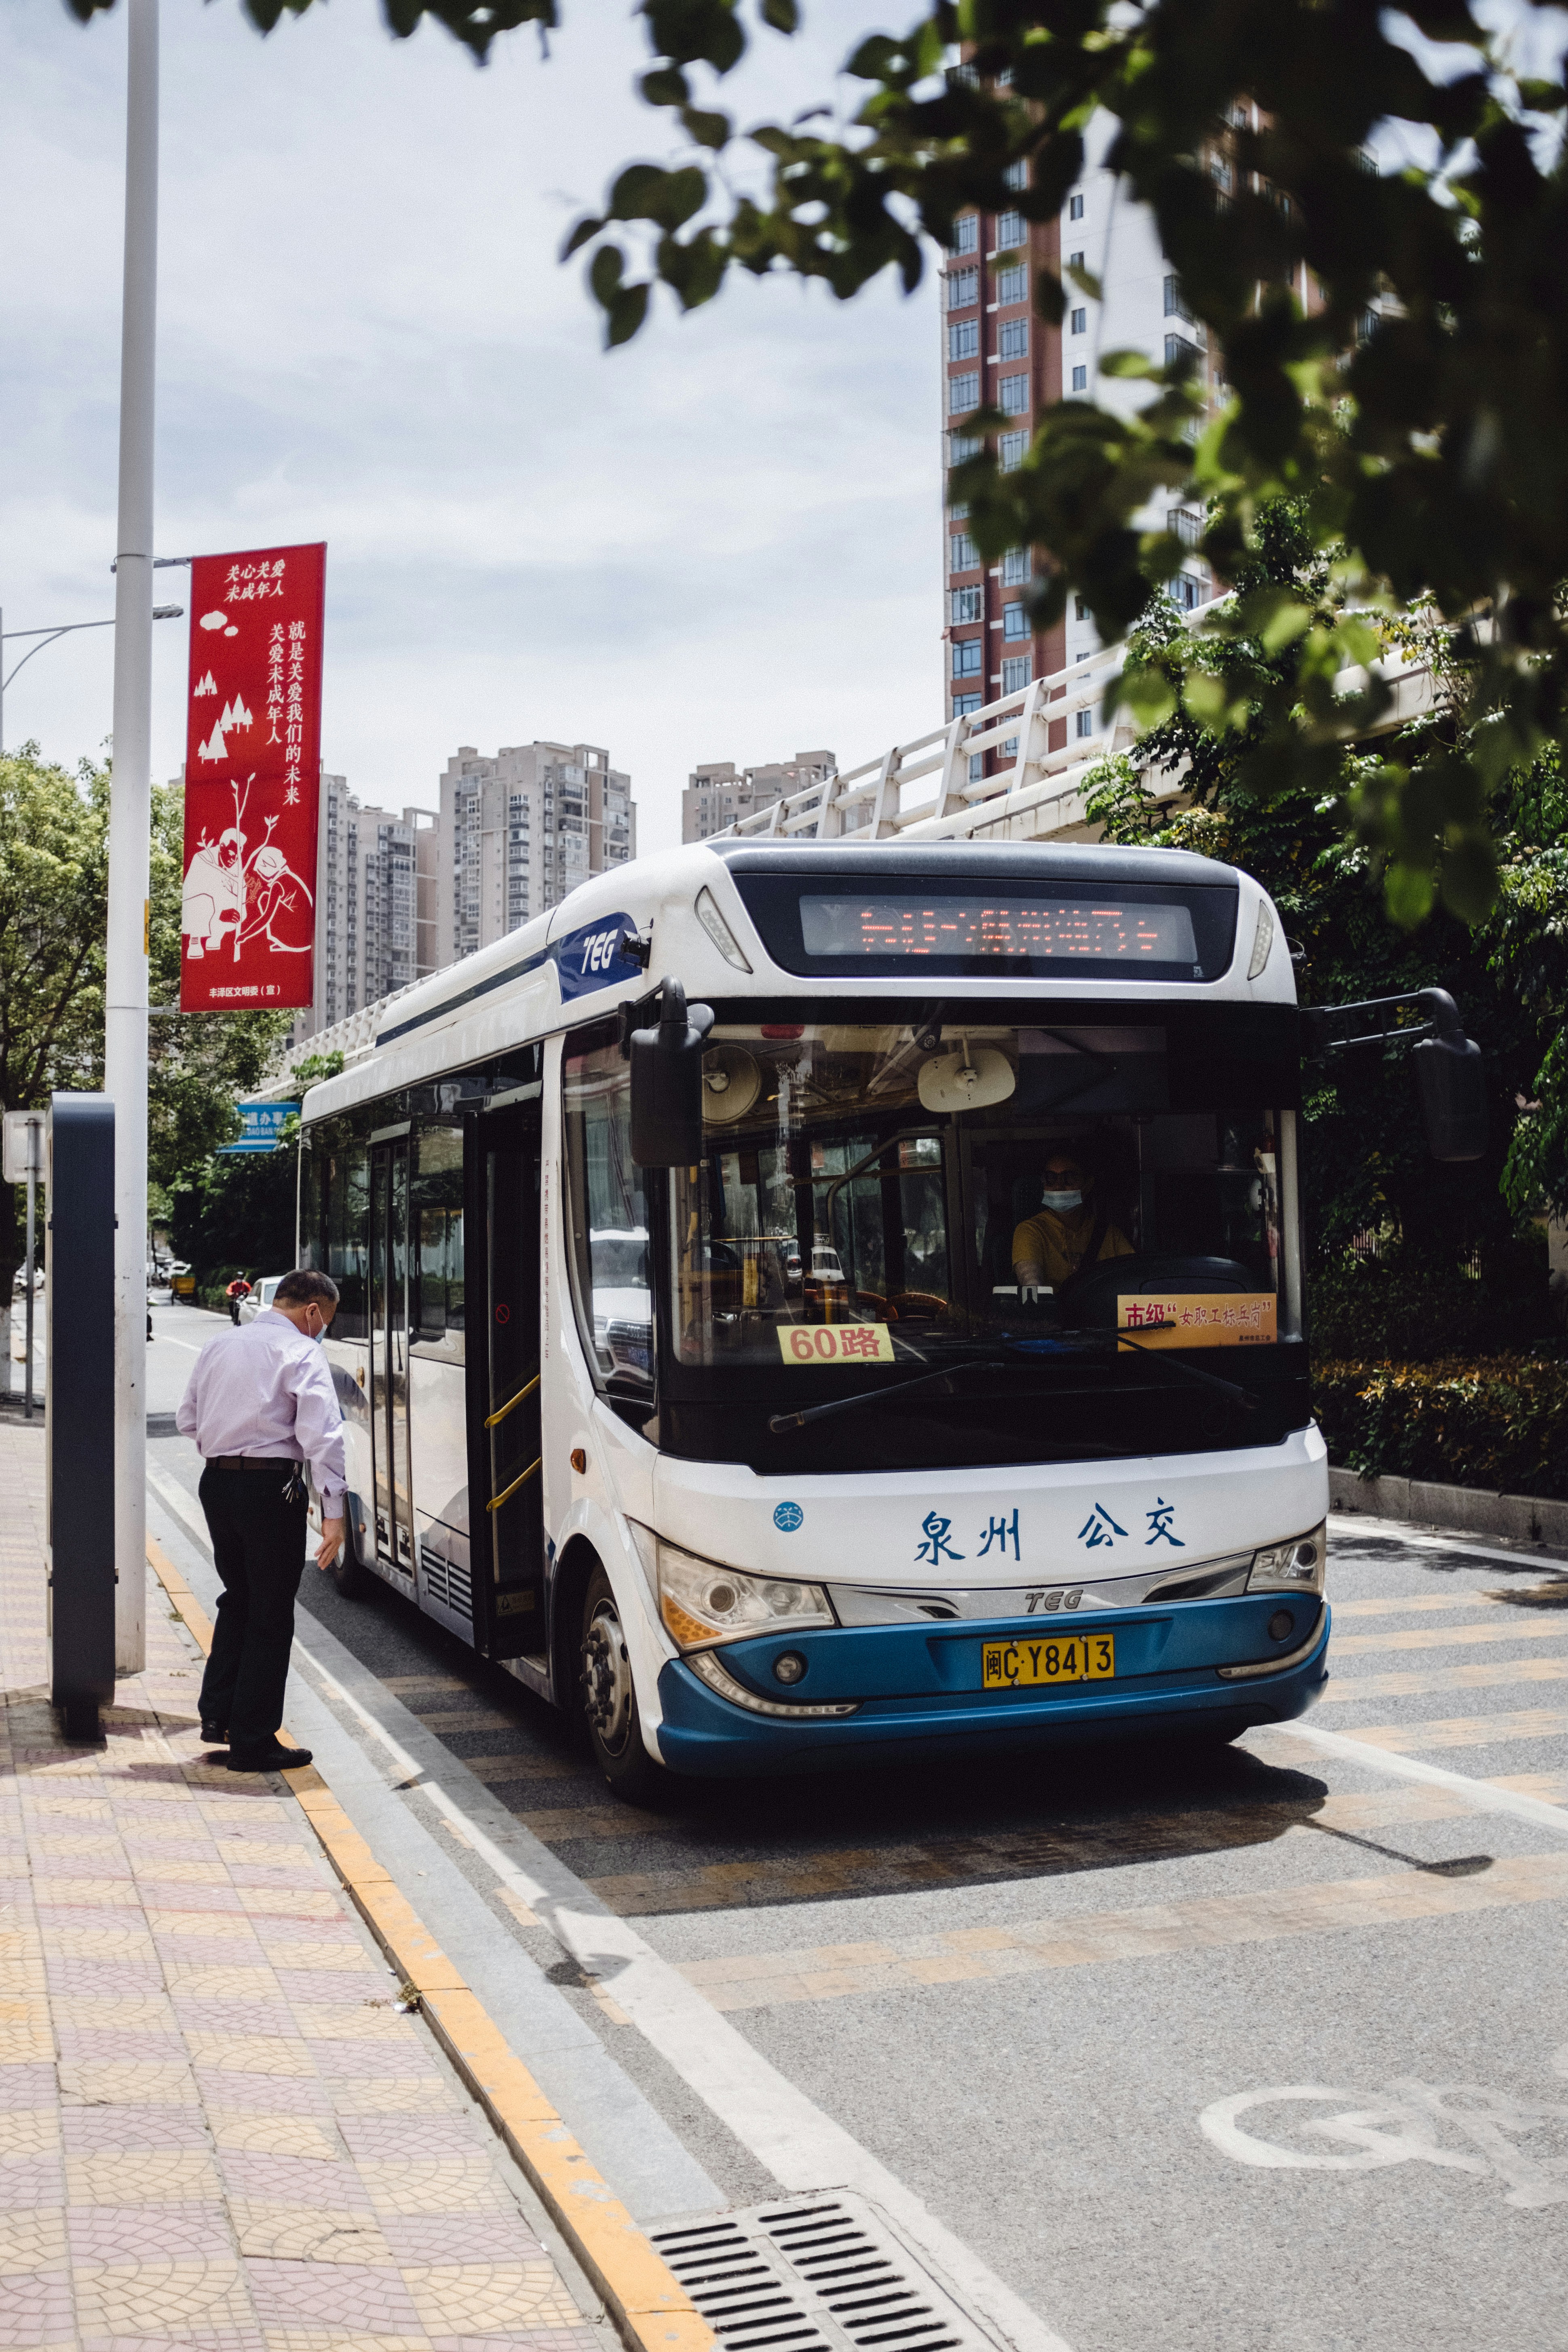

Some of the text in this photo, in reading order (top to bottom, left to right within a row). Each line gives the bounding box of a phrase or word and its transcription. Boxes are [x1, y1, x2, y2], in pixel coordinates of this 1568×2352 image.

[224, 559, 285, 583] 关心关爱
[223, 580, 284, 602] 未成年人
[266, 623, 285, 745] 关爱未成年人
[283, 621, 306, 805] 就是关爱我们的未来
[581, 929, 618, 974] TEG
[790, 1328, 880, 1360] 60路
[914, 1497, 1186, 1566] 泉州 公交
[1024, 1589, 1084, 1613] TEG
